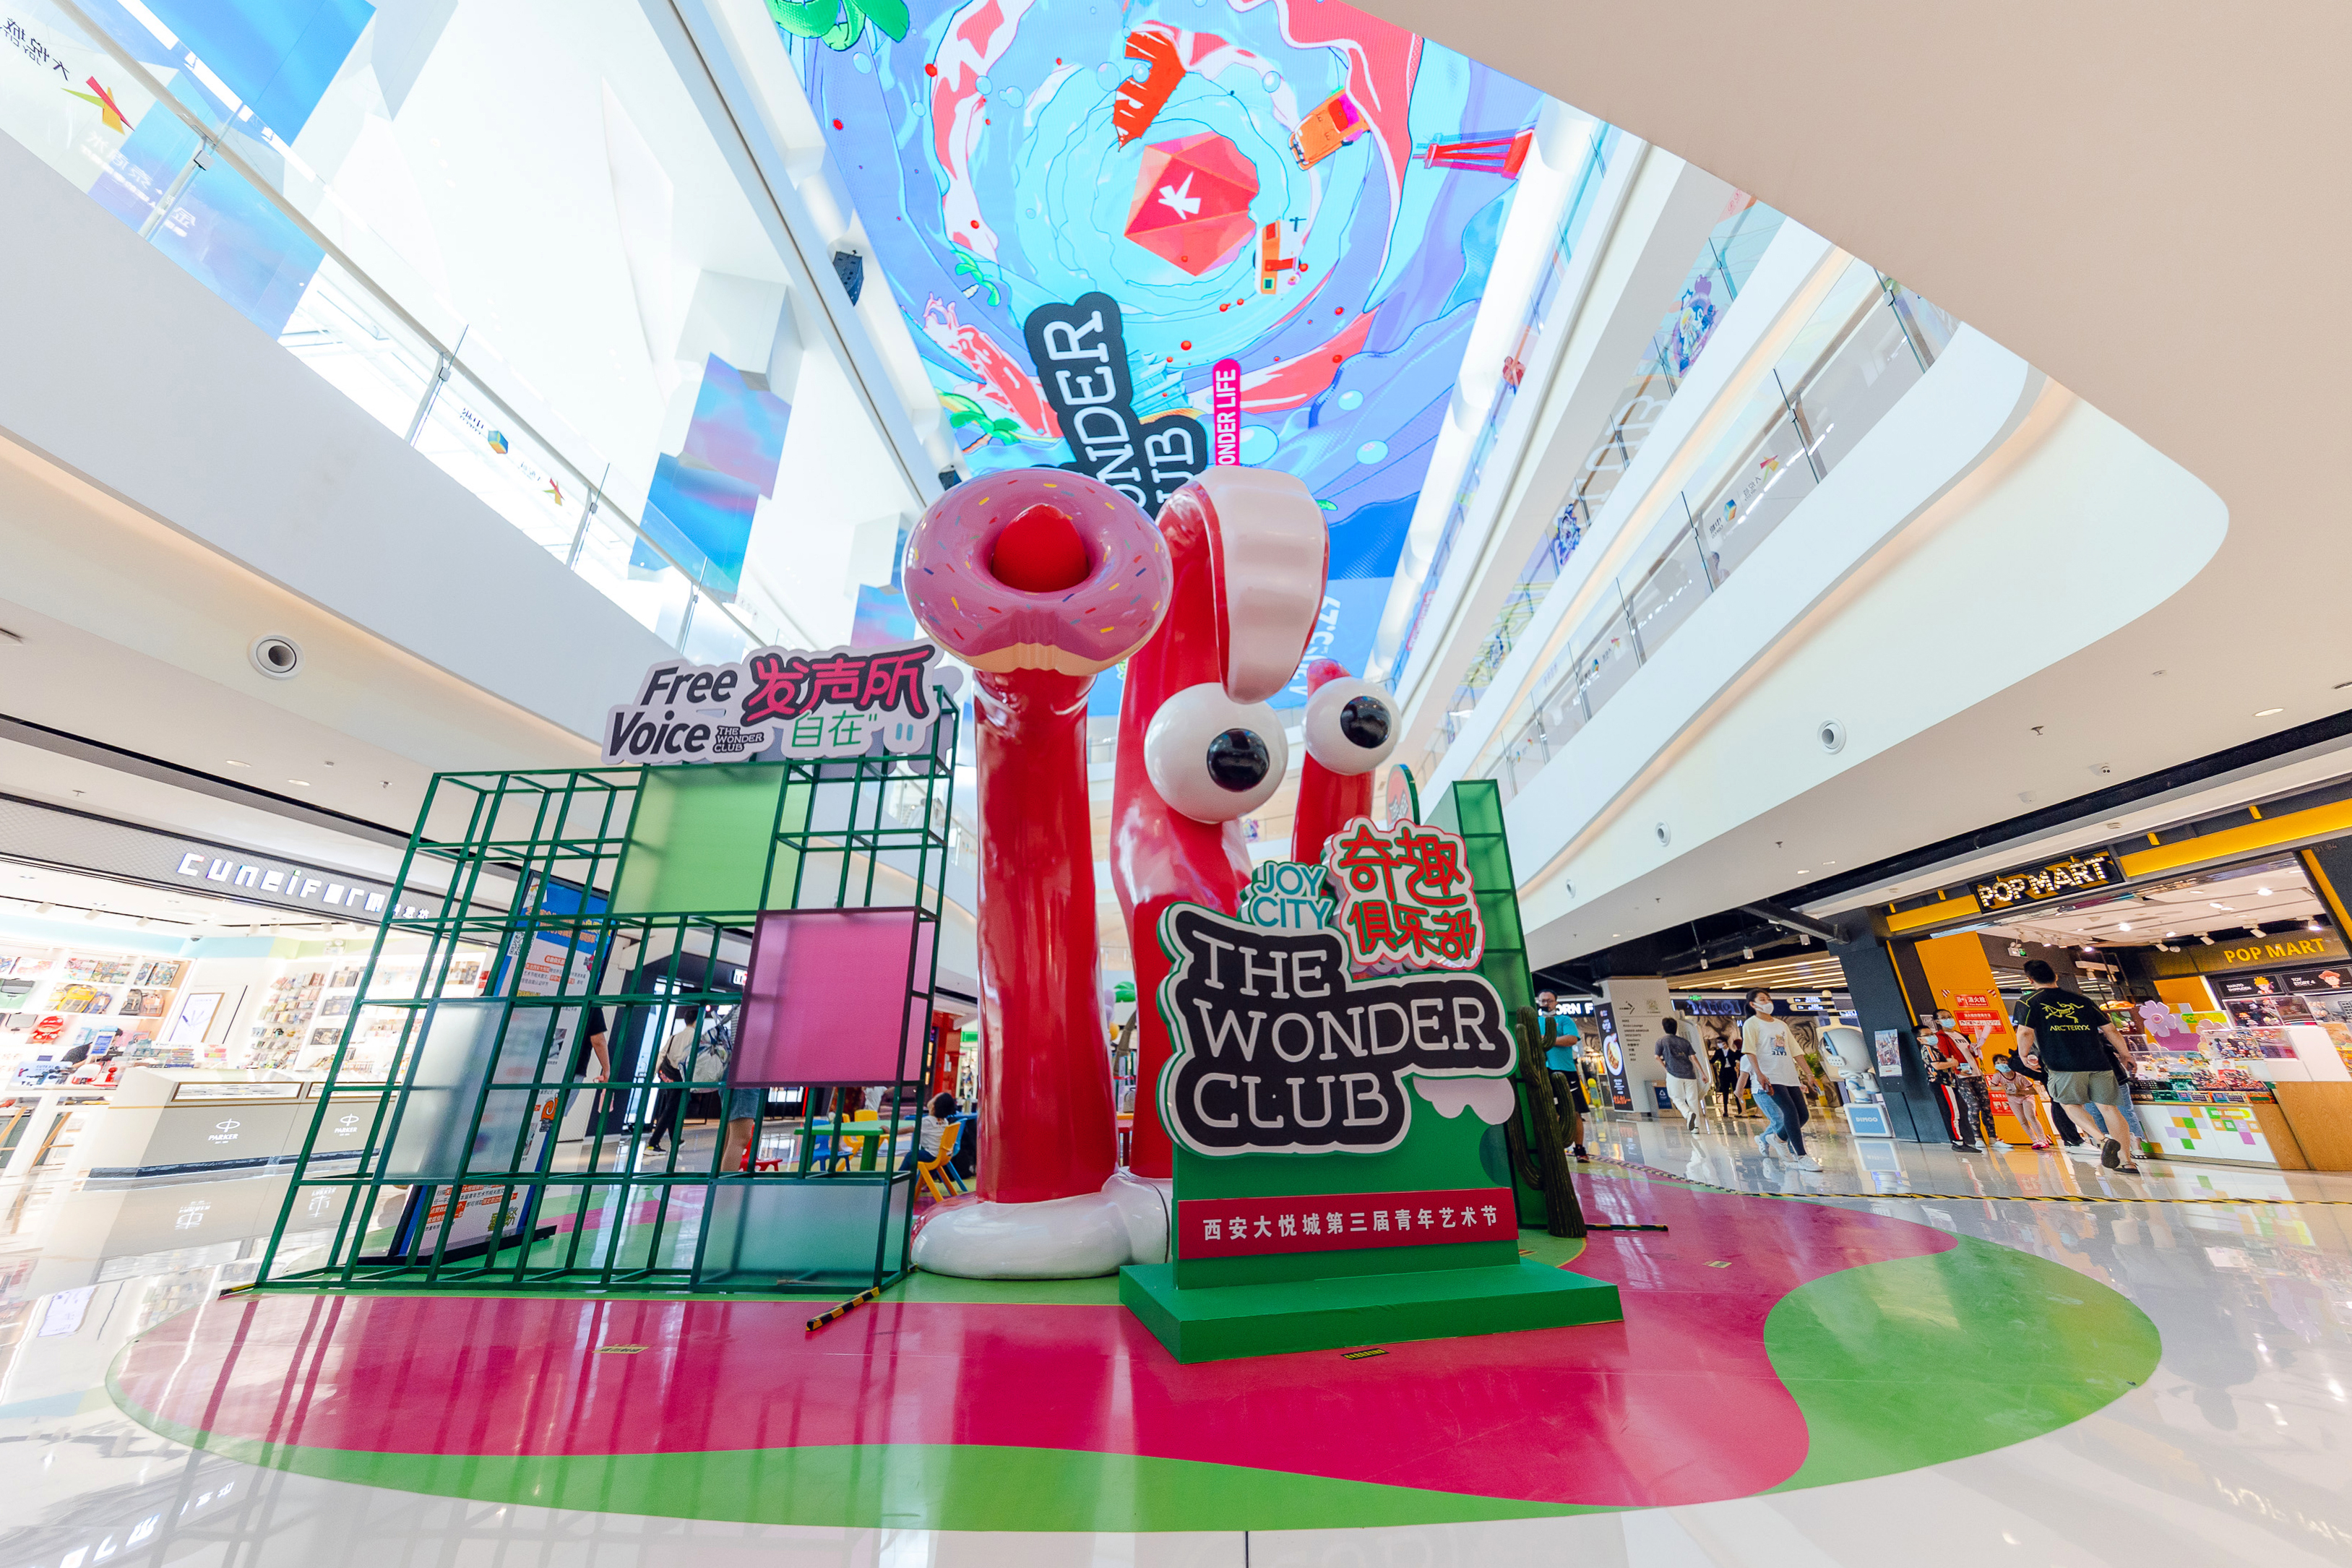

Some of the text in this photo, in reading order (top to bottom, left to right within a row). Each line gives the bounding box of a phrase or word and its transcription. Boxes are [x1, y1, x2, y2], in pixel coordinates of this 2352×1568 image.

[1215, 369, 1237, 408] LIFE
[641, 665, 738, 706] Free
[746, 649, 930, 721] 发声所
[608, 709, 711, 756] Voice
[718, 733, 762, 743] WONDER
[1257, 863, 1326, 897] JOY
[1340, 824, 1465, 906] 奇趣
[1977, 856, 2107, 908] POP MART
[1253, 897, 1335, 931] CITY
[1340, 900, 1475, 960] 俱乐部
[1192, 929, 1331, 999] THE
[2223, 938, 2325, 963] POP MART
[1193, 997, 1496, 1061] WONDER
[1194, 1072, 1389, 1128] CLUB
[1204, 1205, 1498, 1241] 西安大悦城第三届青年艺术节
